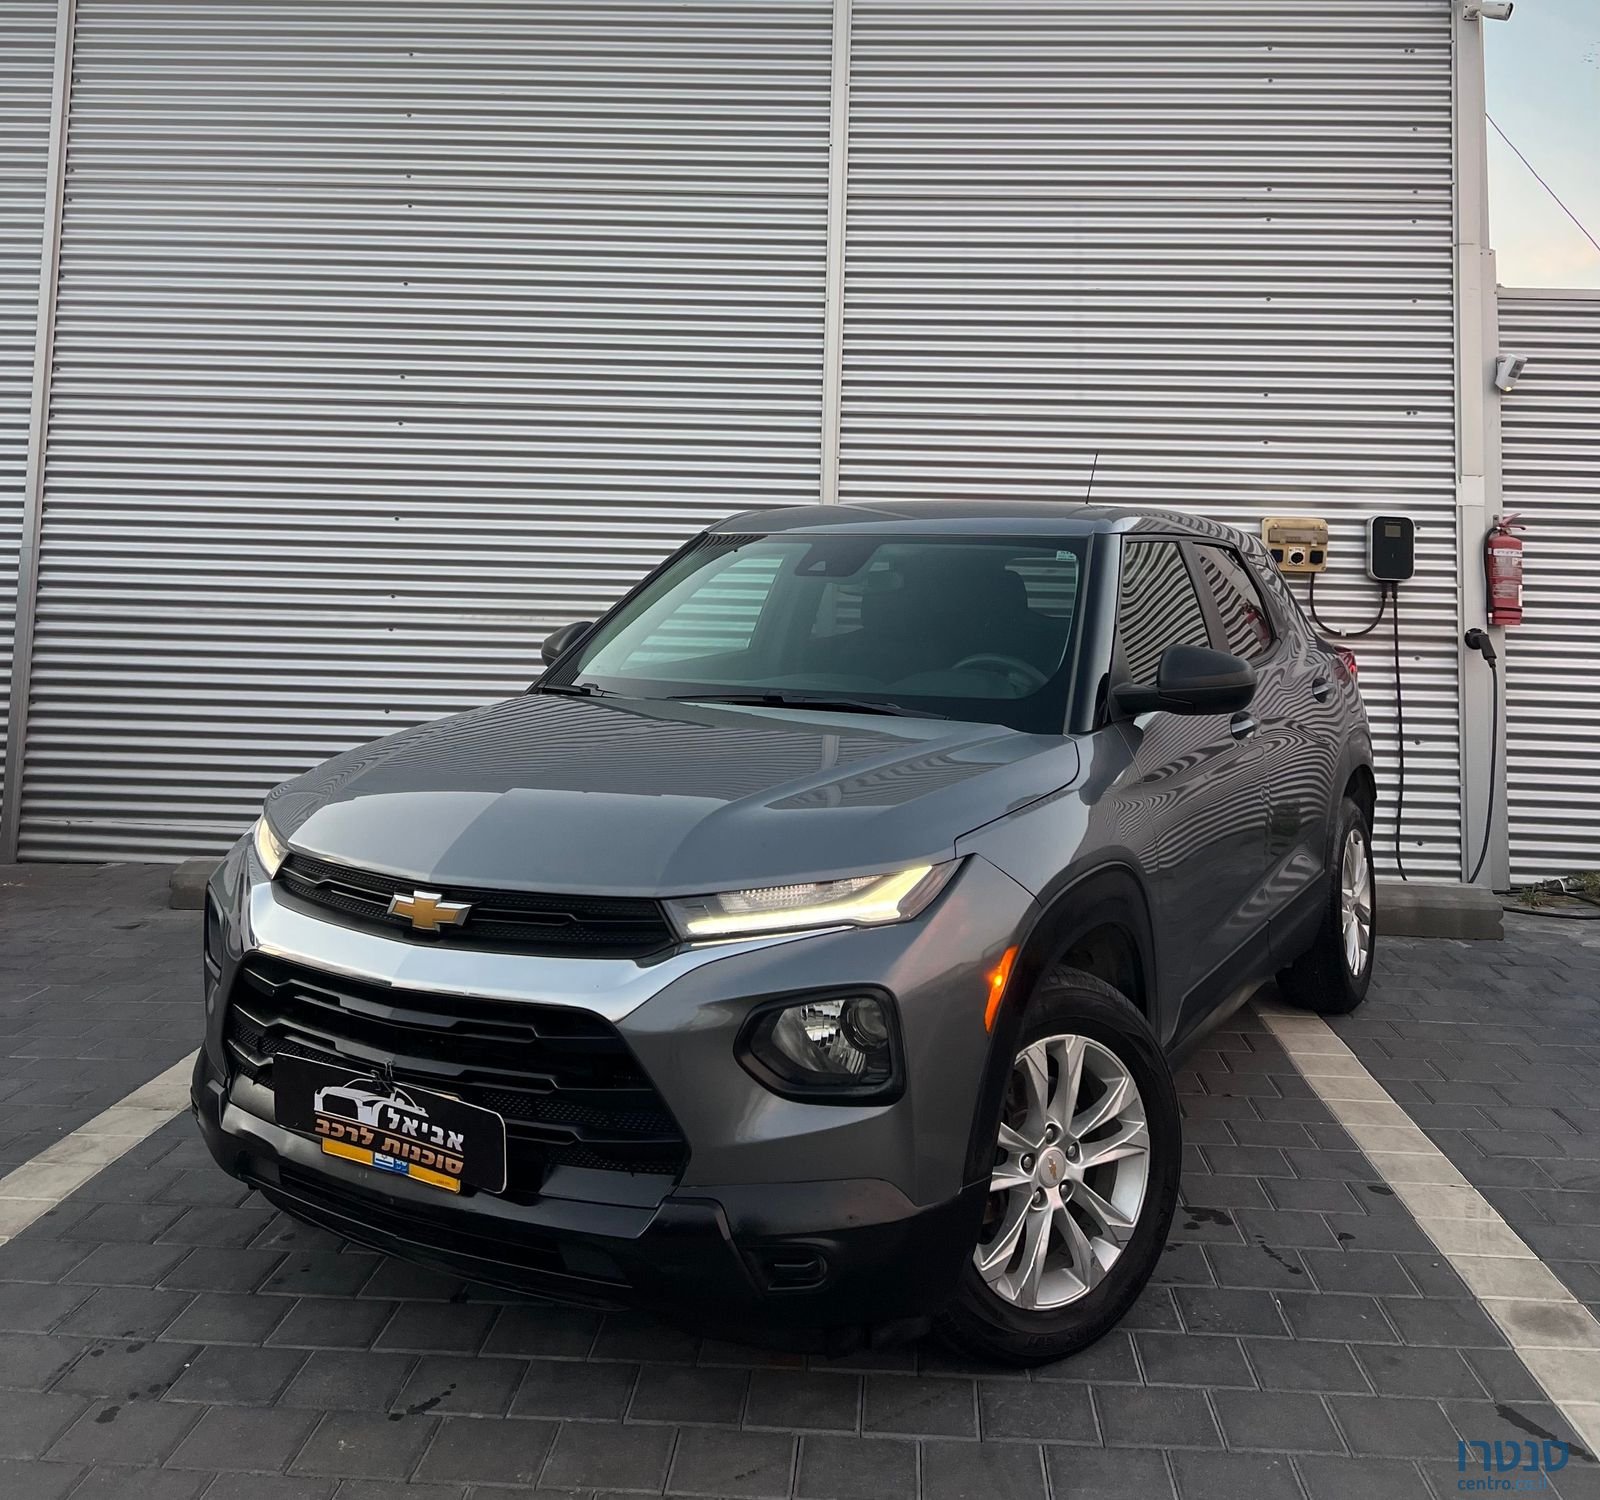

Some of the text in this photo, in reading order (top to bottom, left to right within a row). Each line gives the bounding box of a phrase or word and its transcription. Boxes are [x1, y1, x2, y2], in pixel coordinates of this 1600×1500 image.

[315, 1119, 374, 1144] לרכב
[387, 1107, 464, 1152] אביאל
[382, 1137, 464, 1174] סוכנות
